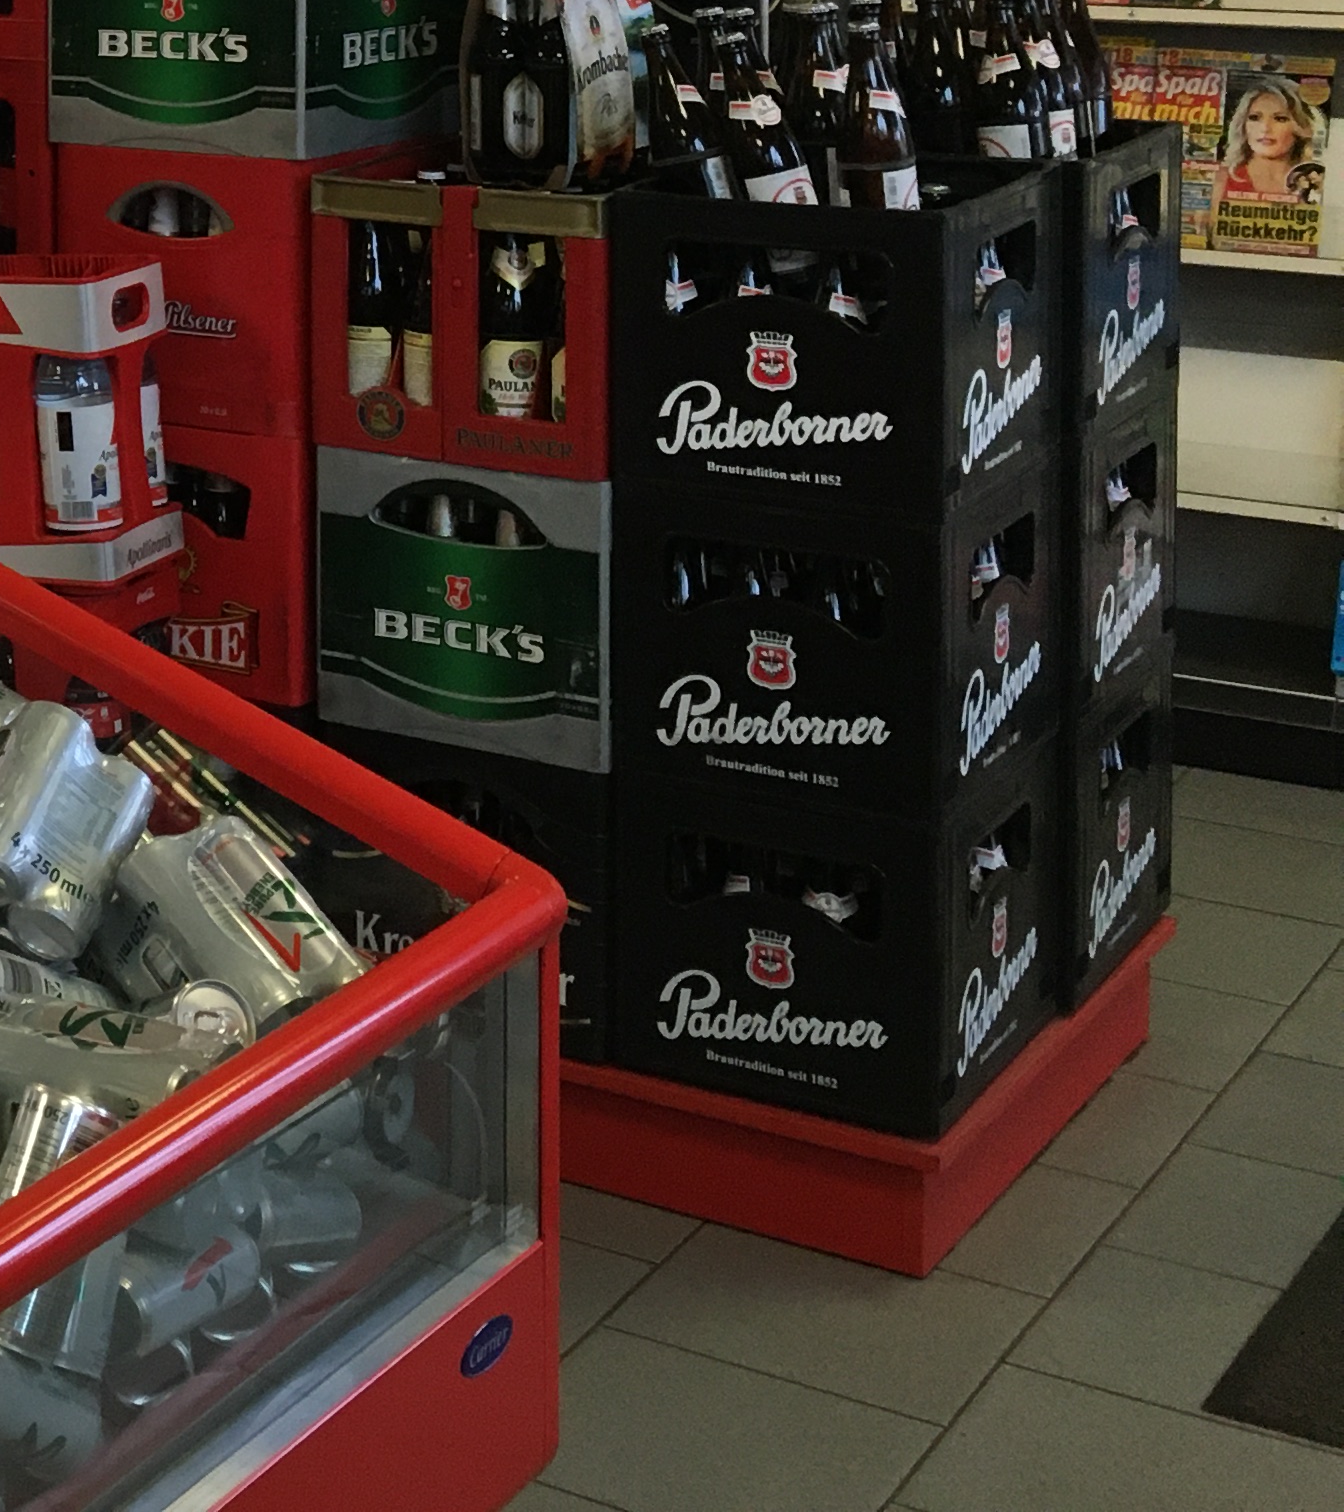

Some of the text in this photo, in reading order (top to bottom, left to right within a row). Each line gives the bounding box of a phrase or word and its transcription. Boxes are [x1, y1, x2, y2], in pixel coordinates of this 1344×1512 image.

[97, 26, 249, 64] BECK'S
[342, 19, 439, 69] BECK'S
[1156, 65, 1222, 100] Spaß
[1154, 102, 1218, 126] mich
[1216, 220, 1319, 242] Rückkehr?
[1217, 201, 1319, 226] Reumütige
[163, 300, 237, 334] Pilsener
[656, 379, 894, 456] Paderborner
[456, 426, 574, 460] PAULANER
[706, 460, 842, 487] Brautradition seit 1852
[373, 606, 547, 665] BECK'S
[655, 674, 892, 747] Paderborner
[960, 640, 1042, 776] Paderborner
[705, 754, 840, 788] Brautradition seit 1852
[30, 853, 61, 884] 250
[655, 969, 889, 1050] Paderborner
[705, 1049, 840, 1090] Brautradition seit 1852
